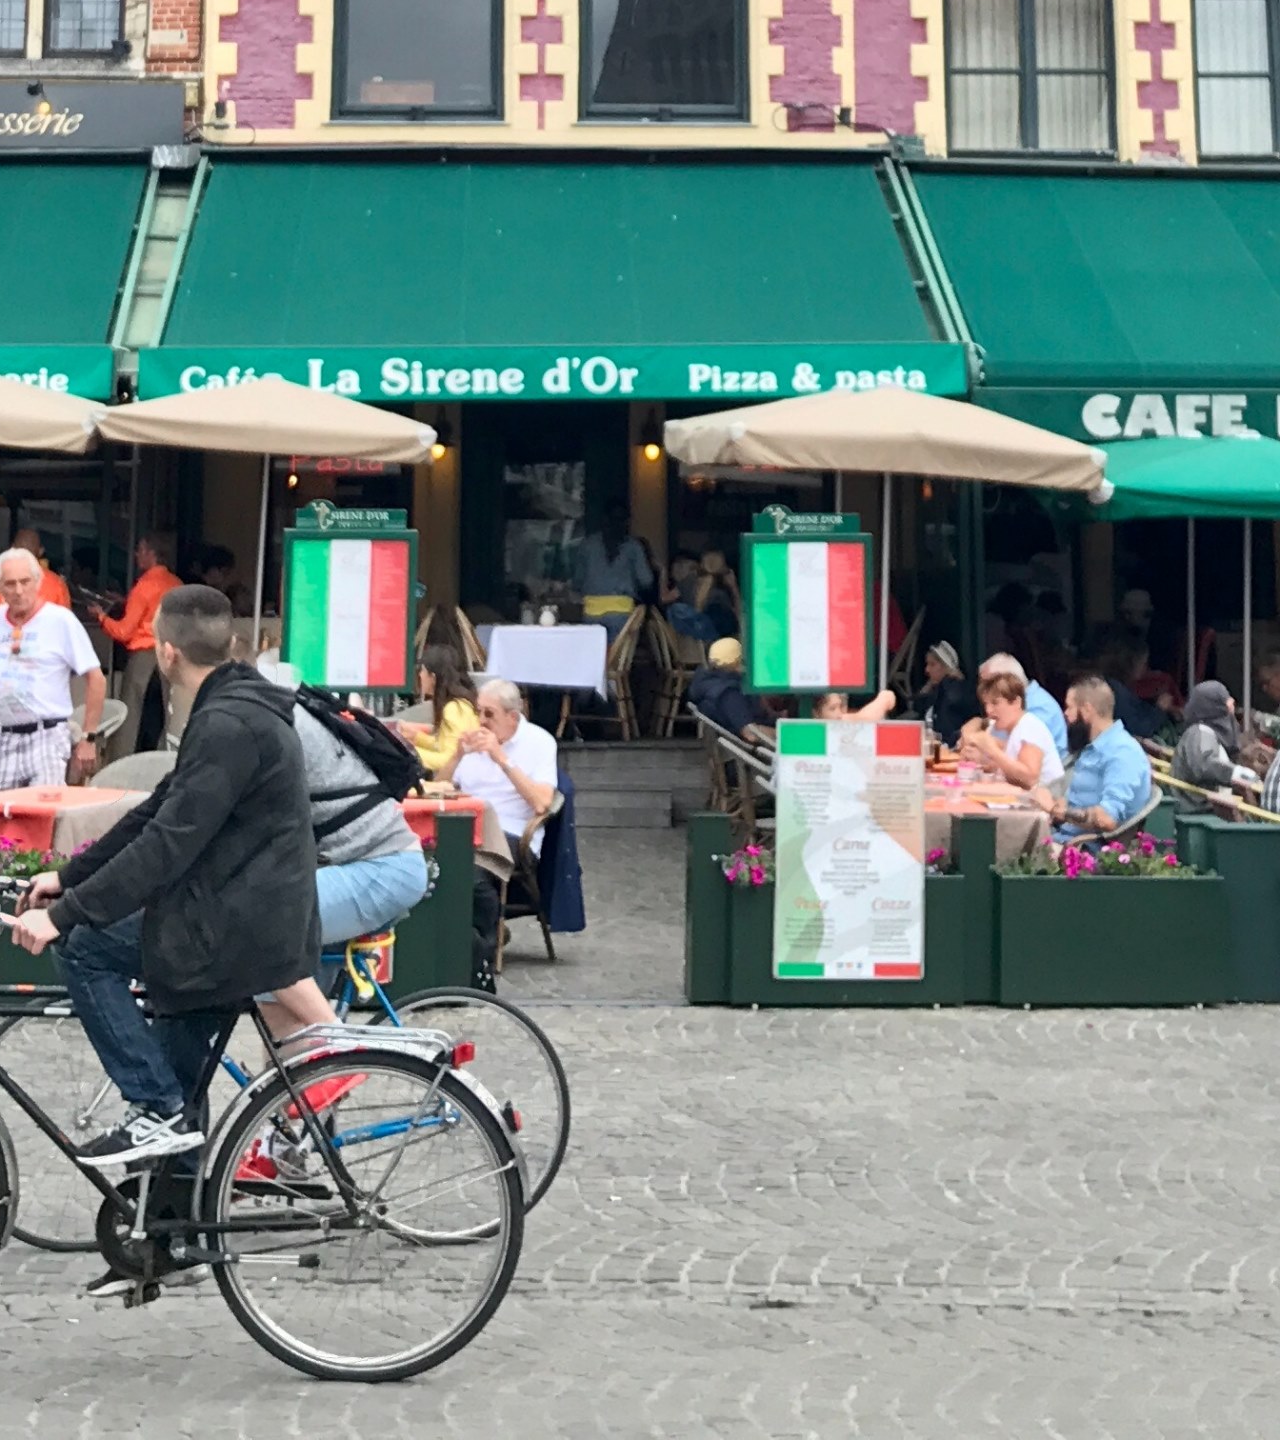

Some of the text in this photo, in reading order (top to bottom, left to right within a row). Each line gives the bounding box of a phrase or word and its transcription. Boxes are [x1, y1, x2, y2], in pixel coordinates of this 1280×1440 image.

[308, 358, 362, 394] La
[379, 357, 525, 396] Sirene
[542, 356, 639, 394] d'Or
[688, 363, 778, 392] Pizza
[791, 362, 822, 392] &
[1081, 394, 1249, 438] CAFE
